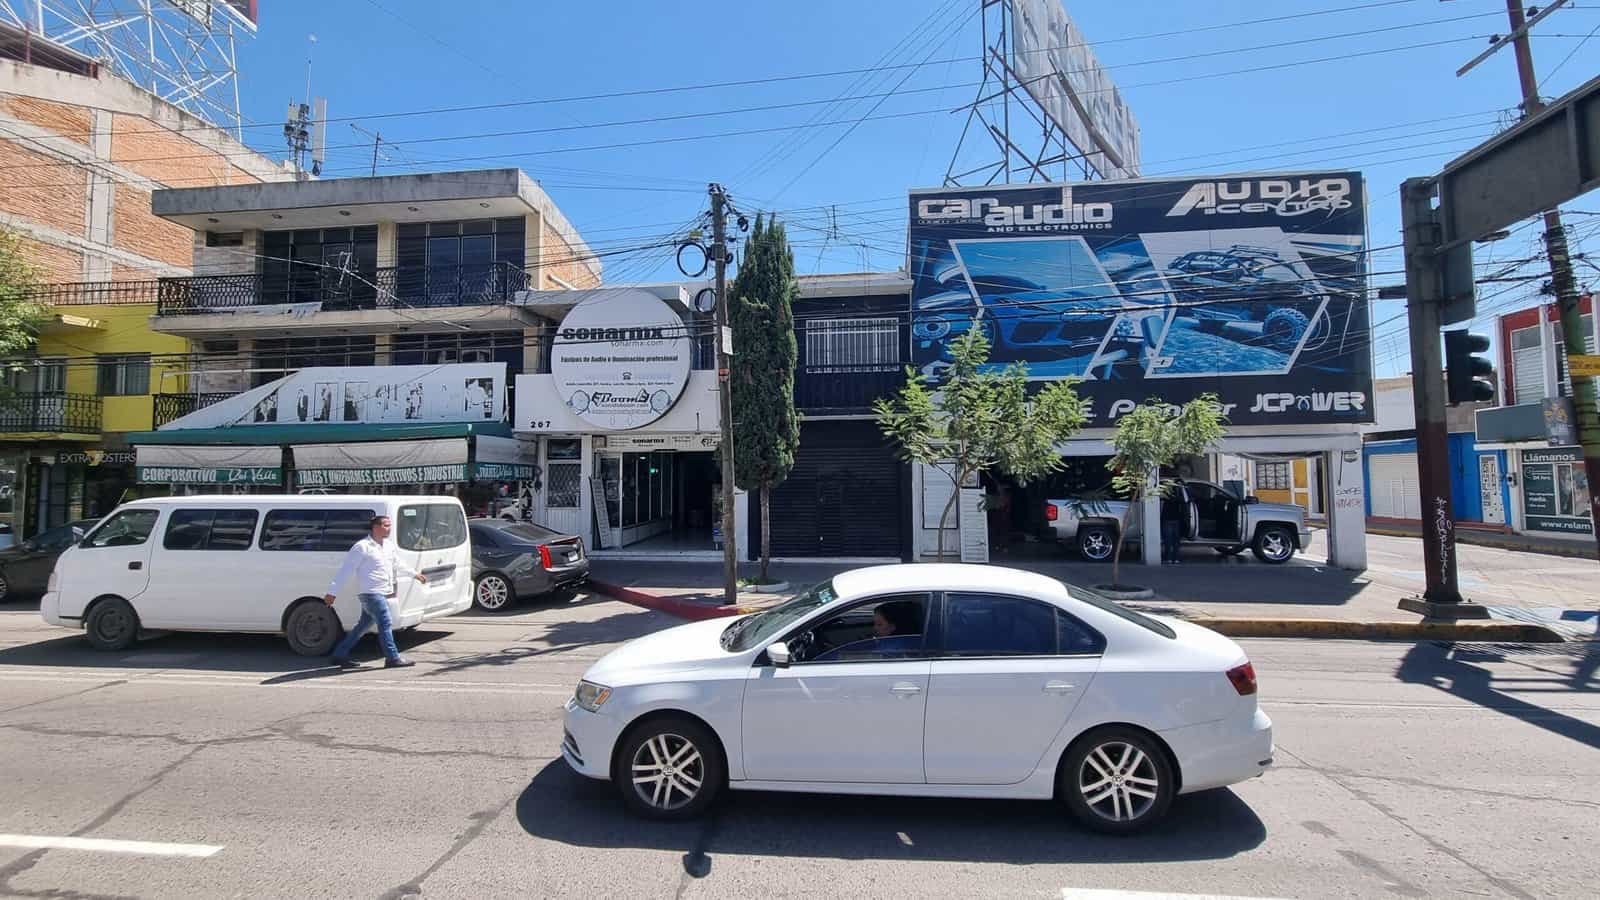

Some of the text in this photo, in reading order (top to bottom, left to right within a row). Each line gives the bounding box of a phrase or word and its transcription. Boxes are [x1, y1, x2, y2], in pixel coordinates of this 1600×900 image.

[1165, 178, 1350, 217] AUDIO
[918, 198, 999, 219] car
[984, 187, 1113, 226] audio
[1019, 222, 1112, 232] ELECTRONICS
[530, 420, 551, 429] 207
[142, 468, 217, 482] CORPORATIVO
